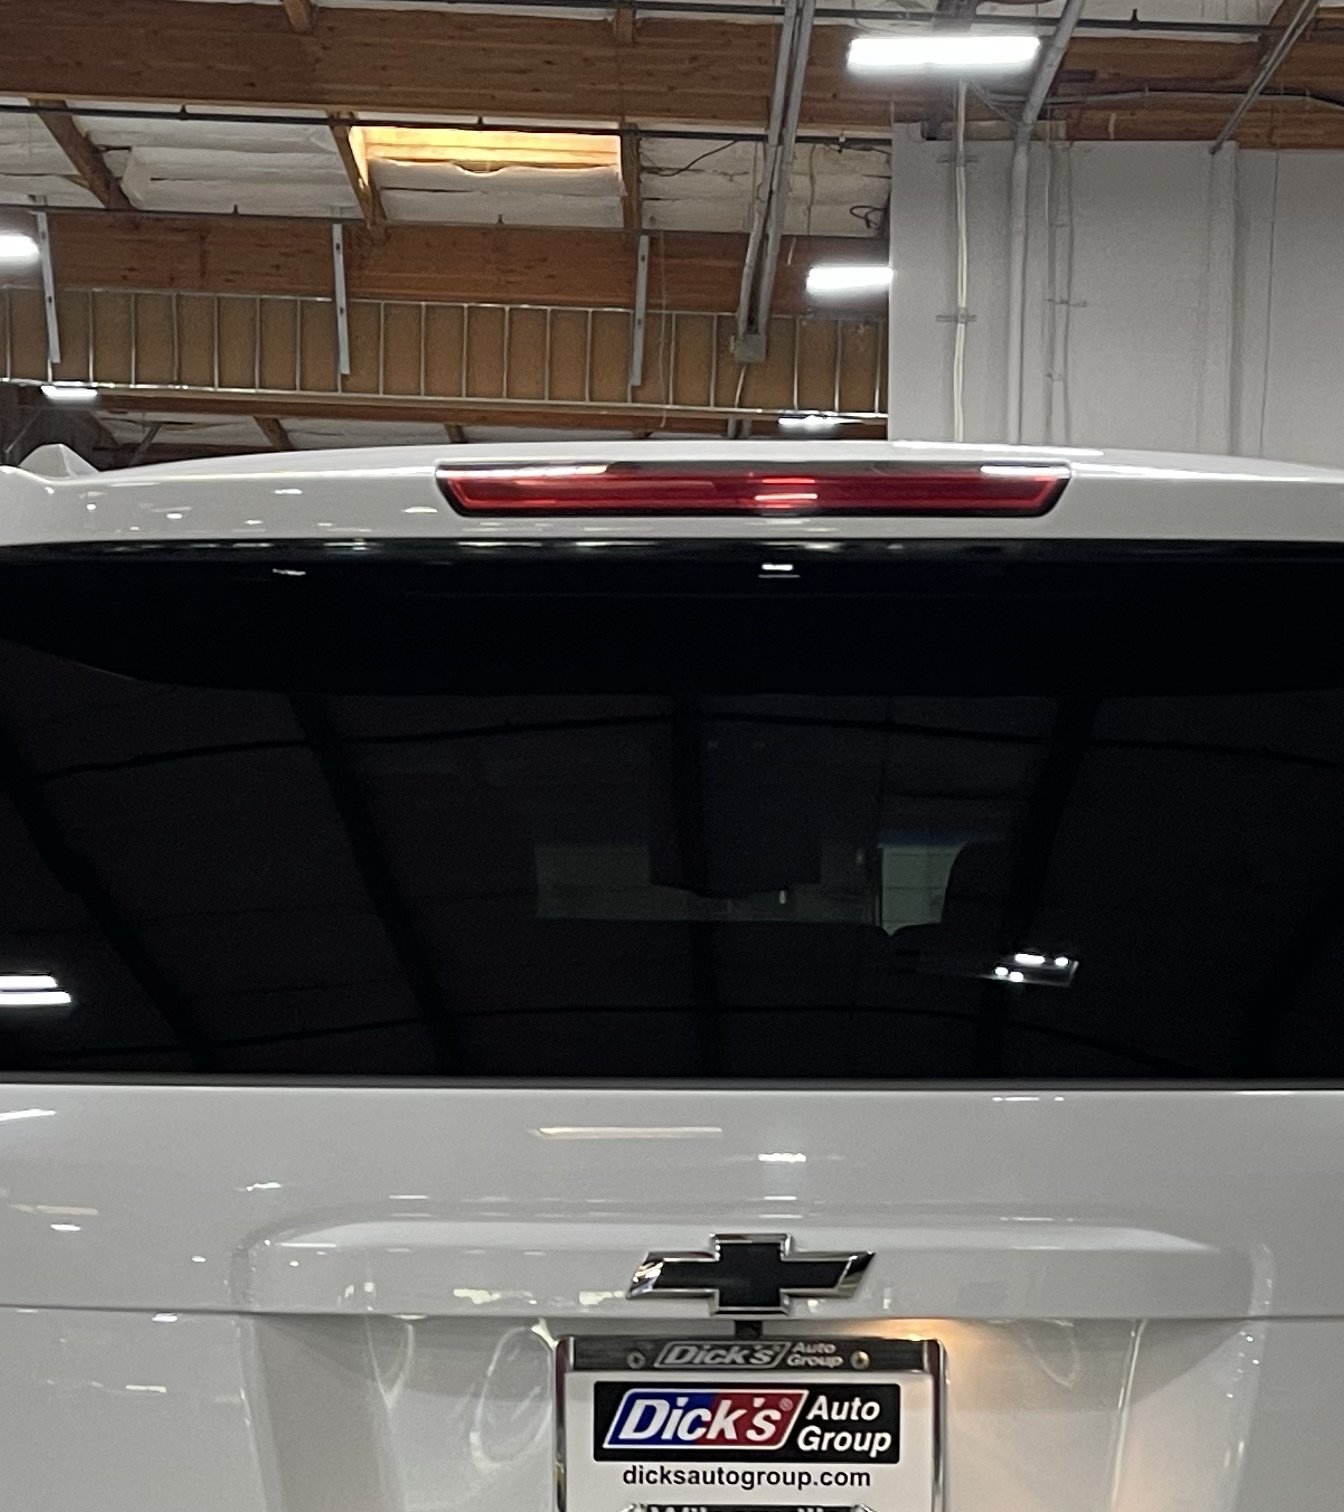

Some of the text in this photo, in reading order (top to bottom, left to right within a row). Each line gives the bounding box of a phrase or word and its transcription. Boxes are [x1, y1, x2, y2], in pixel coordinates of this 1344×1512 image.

[663, 1341, 837, 1365] Dick's Auto
[786, 1353, 844, 1368] Group
[618, 1394, 881, 1442] Dick's Auto
[797, 1425, 893, 1459] Group
[622, 1464, 871, 1491] dicksautogroup.com
